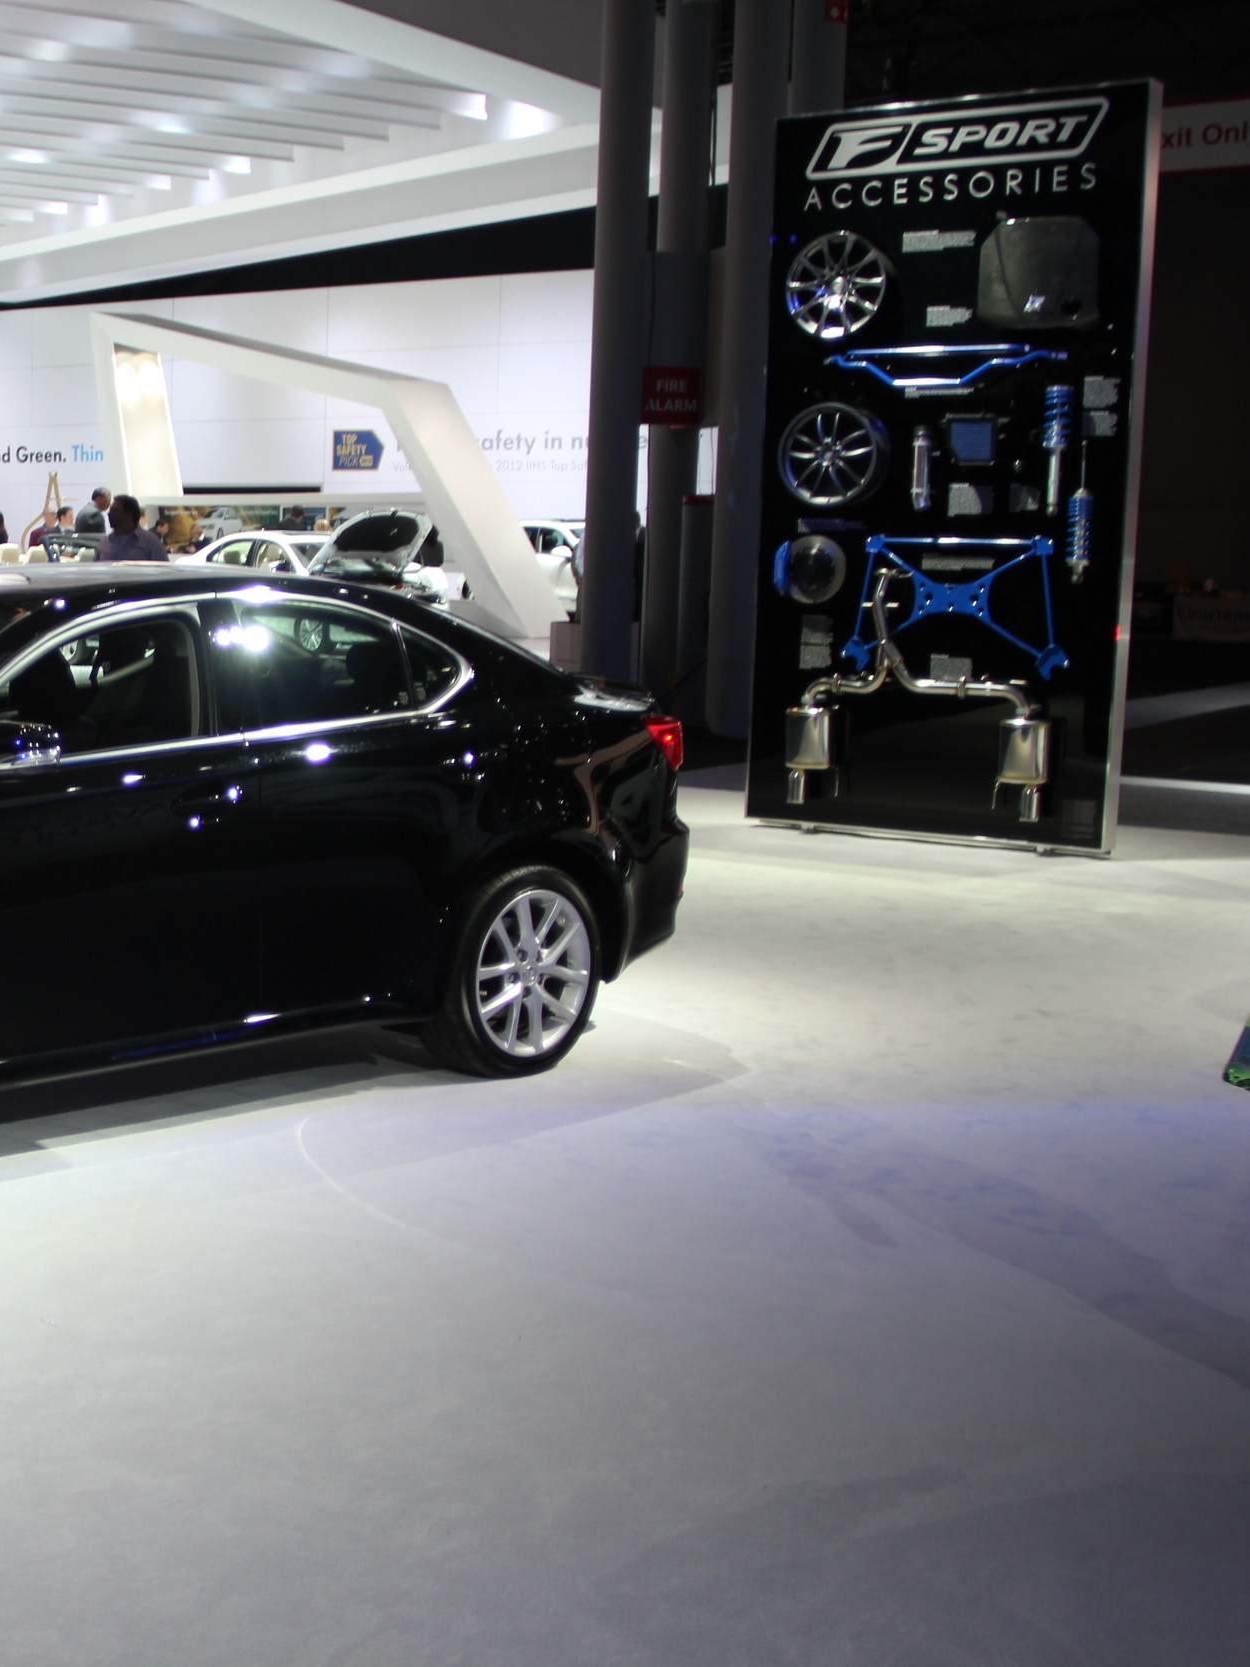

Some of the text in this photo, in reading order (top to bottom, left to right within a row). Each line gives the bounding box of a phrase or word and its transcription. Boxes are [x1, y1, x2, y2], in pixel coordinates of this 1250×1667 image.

[913, 114, 1089, 156] SPORT
[1161, 121, 1250, 149] xit Onl
[803, 161, 1097, 212] ACCESSORIES
[656, 379, 687, 393] FIRE
[645, 398, 698, 412] ALARM
[341, 433, 358, 445] TOP
[479, 430, 537, 455] afety
[544, 431, 565, 450] in
[15, 445, 67, 464] Green.
[336, 444, 367, 456] SAFETY
[338, 455, 359, 467] PICK
[495, 461, 523, 472] 2012
[549, 460, 568, 473] Top
